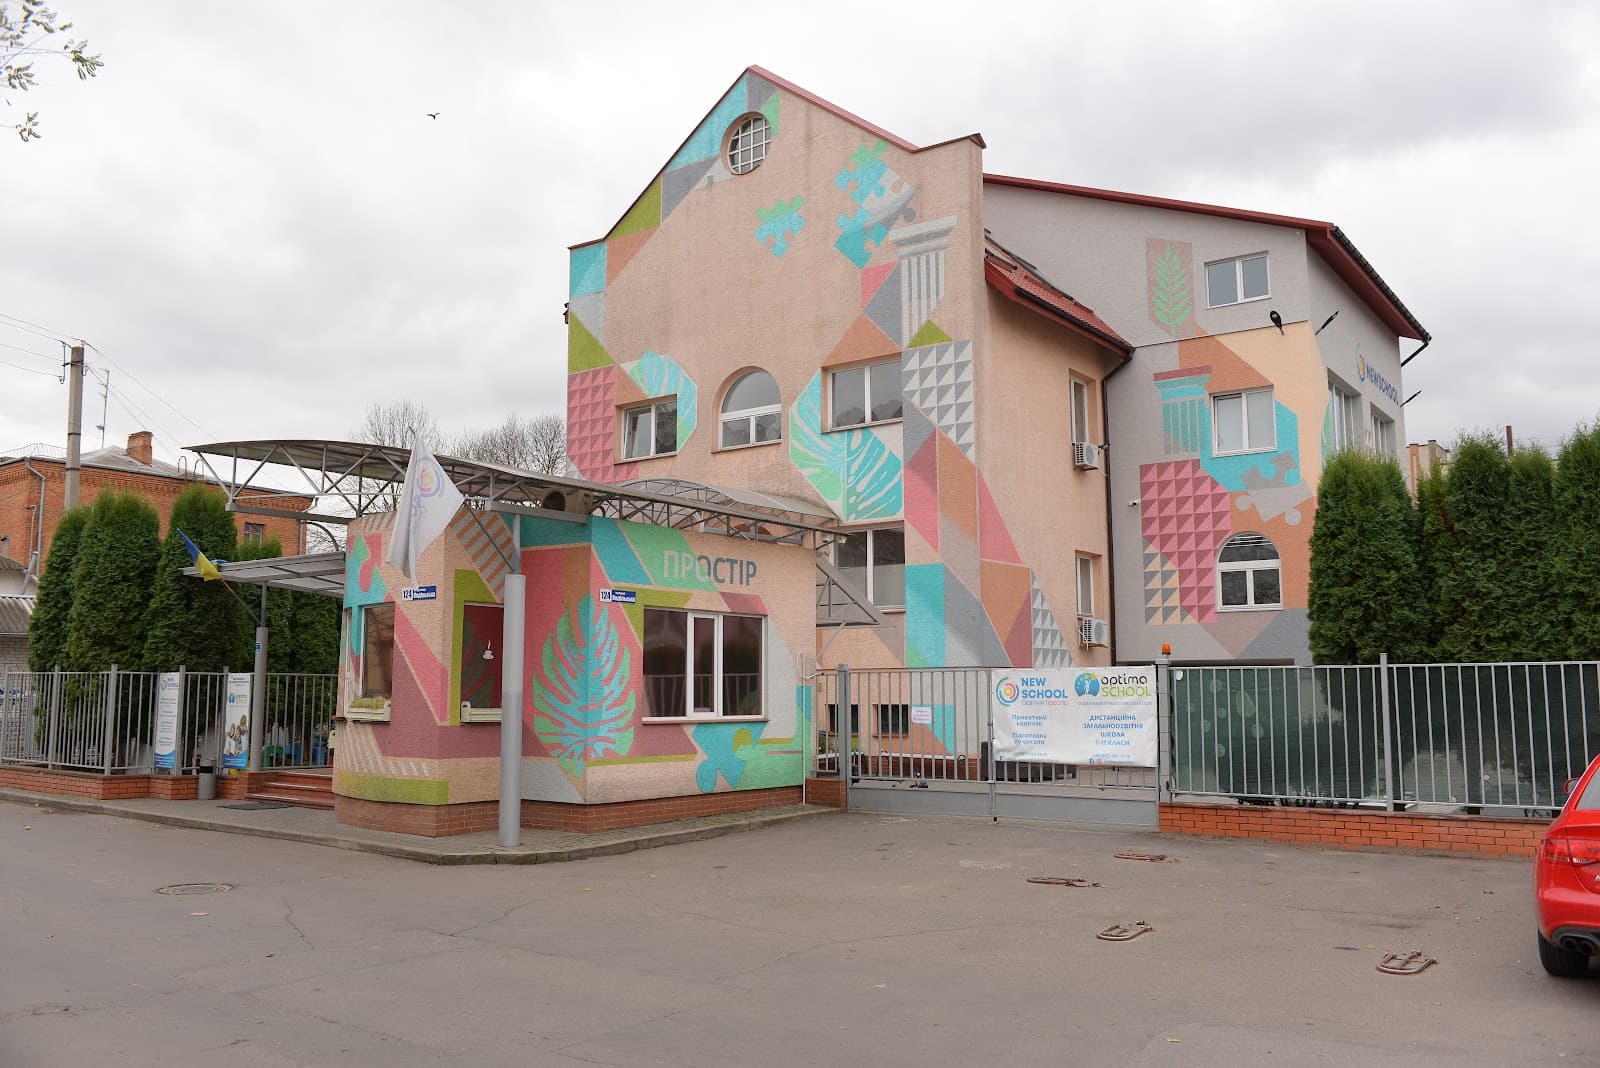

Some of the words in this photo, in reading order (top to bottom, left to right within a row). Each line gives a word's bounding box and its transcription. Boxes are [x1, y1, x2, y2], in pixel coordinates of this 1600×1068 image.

[662, 549, 757, 587] ПРОСТІР
[601, 591, 611, 600] 124
[1021, 677, 1047, 687] NEW
[1101, 673, 1148, 685] optima
[1021, 689, 1068, 699] SCHOOL
[1101, 686, 1151, 697] SCHOOL
